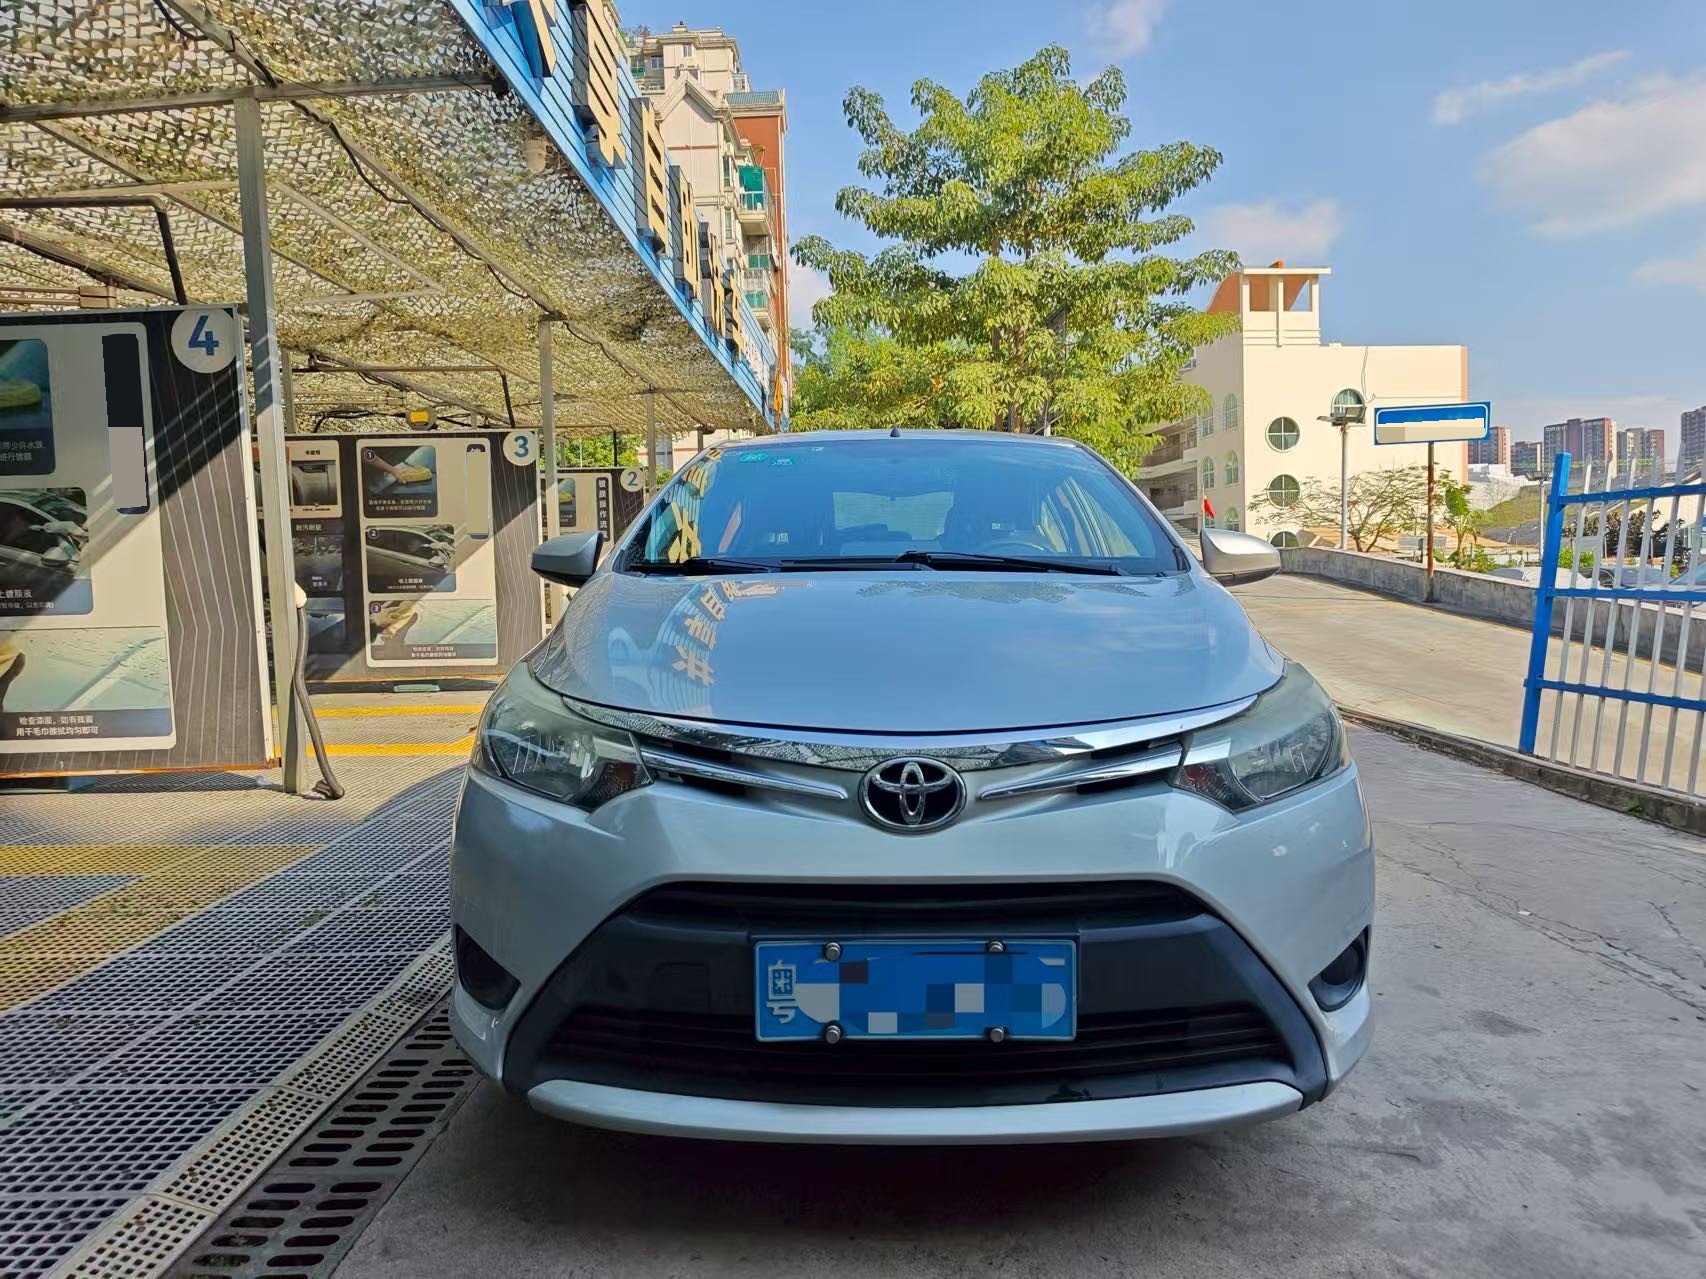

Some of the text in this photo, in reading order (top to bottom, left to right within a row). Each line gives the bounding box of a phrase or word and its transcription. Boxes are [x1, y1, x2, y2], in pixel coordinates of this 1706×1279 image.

[187, 315, 219, 356] 4
[514, 436, 529, 458] 3
[627, 471, 638, 487] 2
